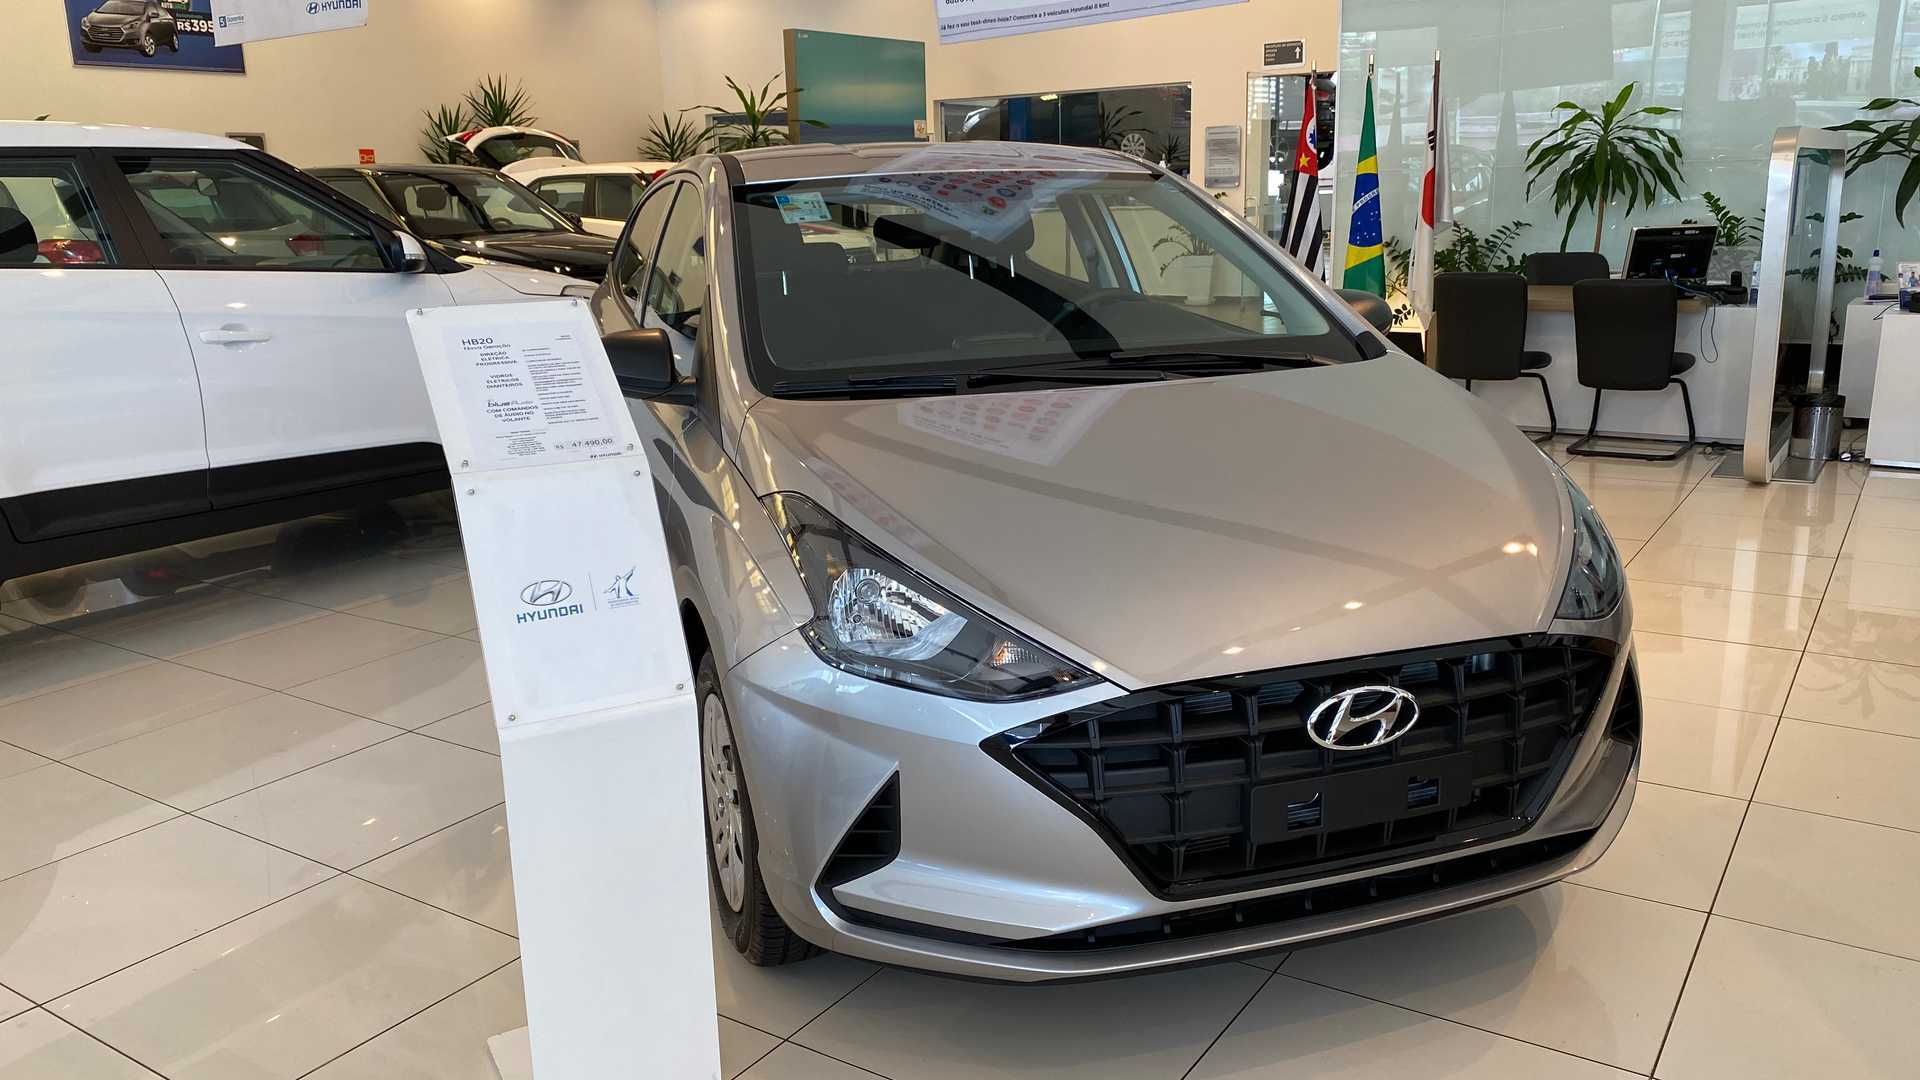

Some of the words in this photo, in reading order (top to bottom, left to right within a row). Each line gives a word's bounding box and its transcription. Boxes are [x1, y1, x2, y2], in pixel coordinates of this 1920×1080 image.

[321, 0, 361, 11] HYUNDAI
[462, 337, 493, 346] HB20
[516, 604, 583, 624] HYUNDAI
